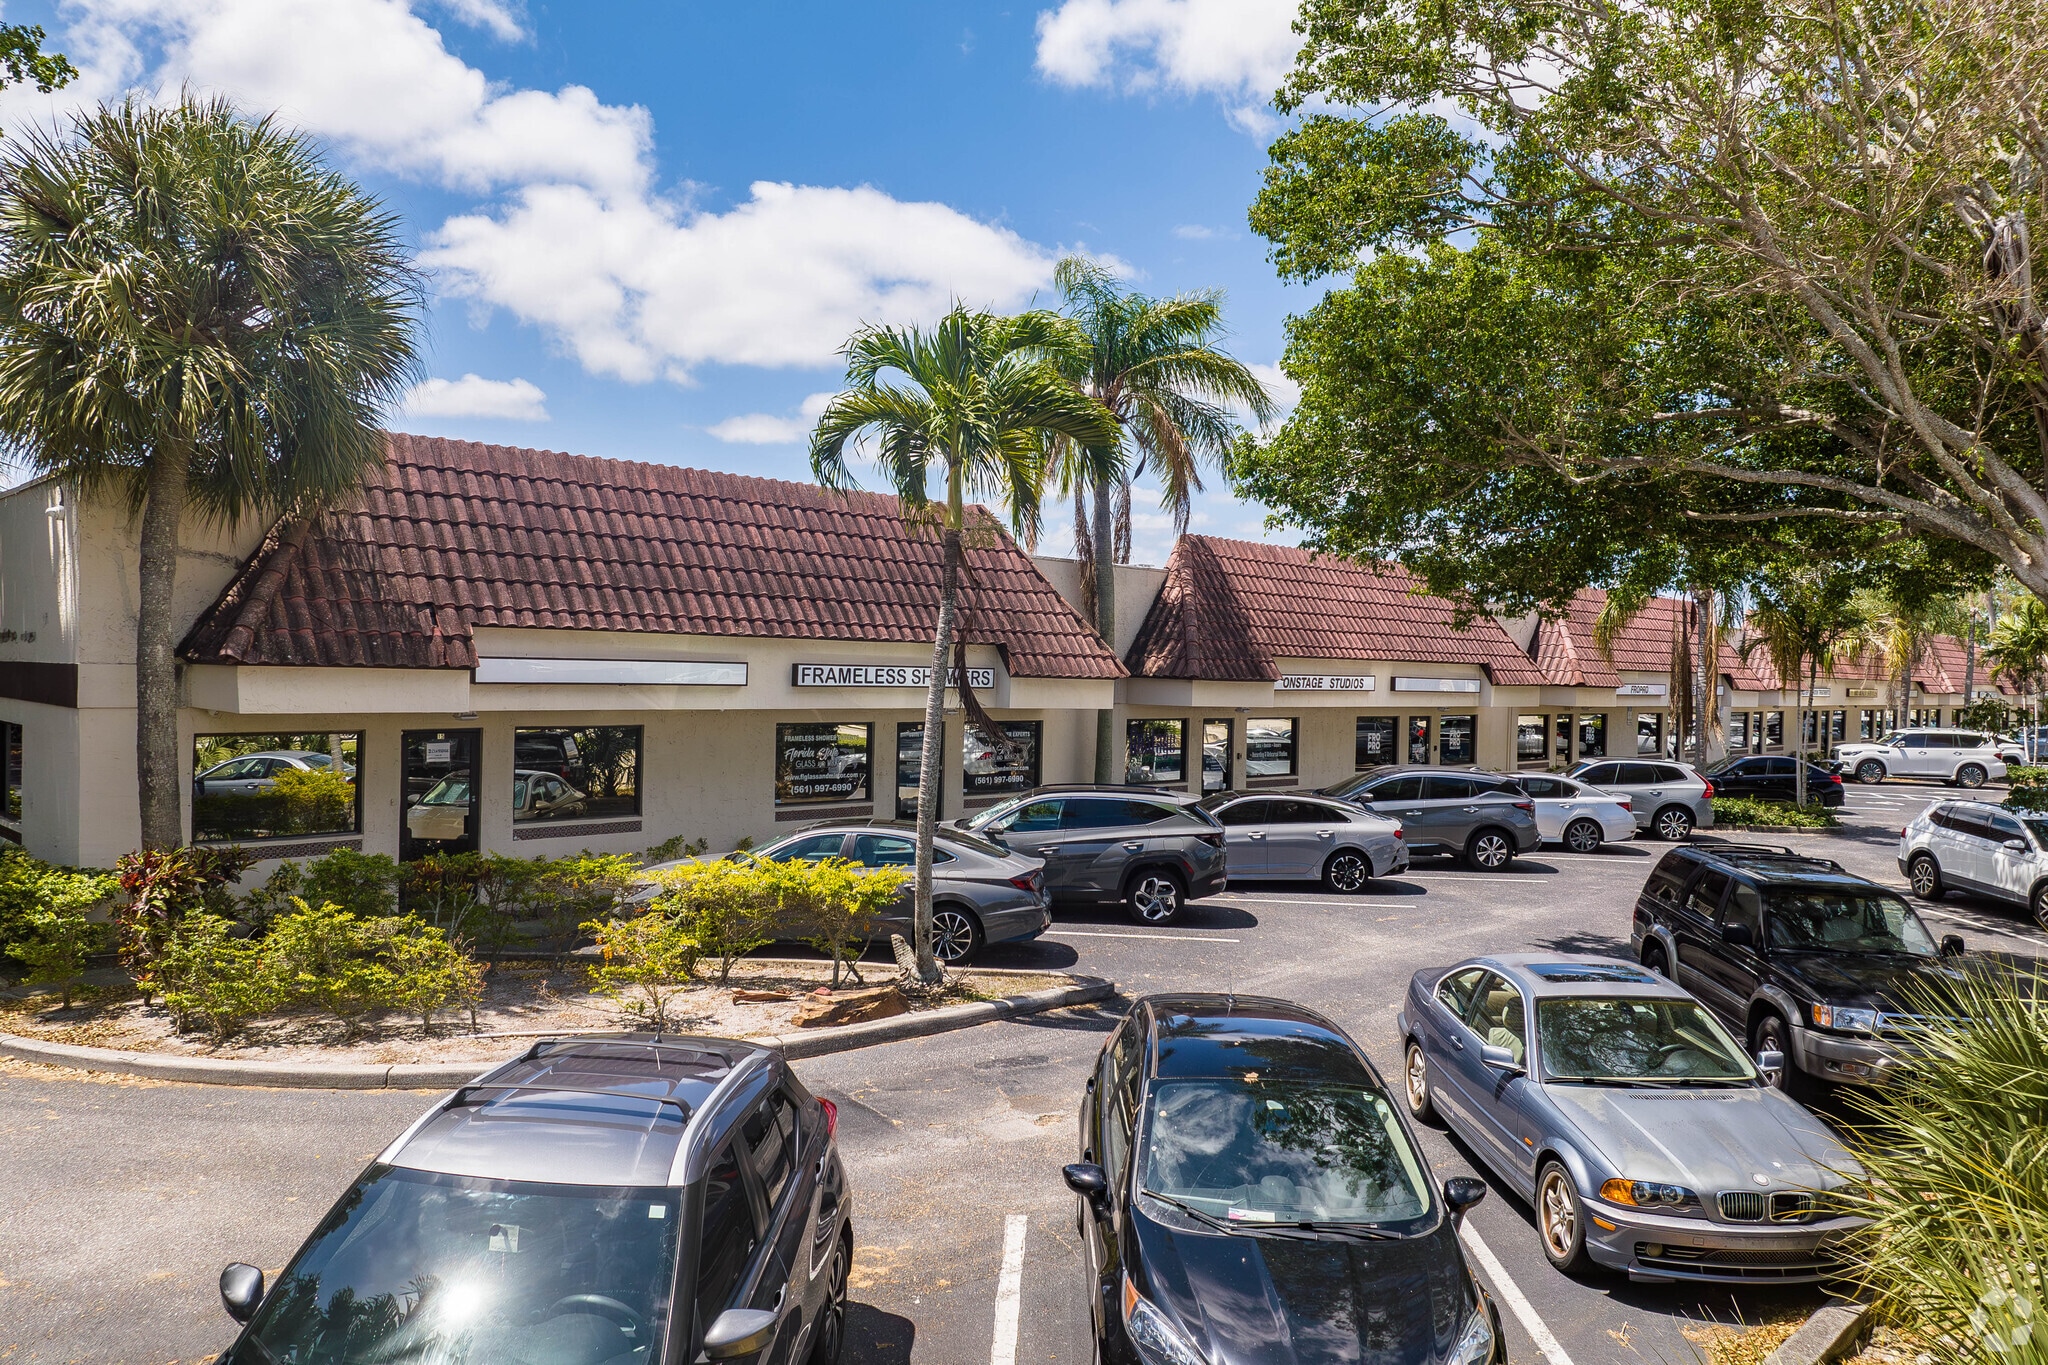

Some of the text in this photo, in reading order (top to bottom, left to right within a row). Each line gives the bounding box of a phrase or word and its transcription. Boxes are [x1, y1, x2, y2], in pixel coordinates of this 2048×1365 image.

[801, 667, 990, 686] FRAMELESS SHWRS
[1283, 677, 1364, 689] ONSTAGE STUDIOS
[1631, 685, 1648, 693] FROPRO
[784, 734, 815, 742] FRAMELESS
[815, 734, 837, 742] SHOWER
[1367, 733, 1381, 742] FRO
[1449, 730, 1461, 738] FRO
[1367, 741, 1381, 750] PRO
[1449, 738, 1461, 746] PRO
[784, 747, 815, 762] Florida
[795, 760, 816, 768] GLASS
[974, 775, 1024, 786] (561) 997-6990
[790, 783, 852, 796] (561) 997-6990
